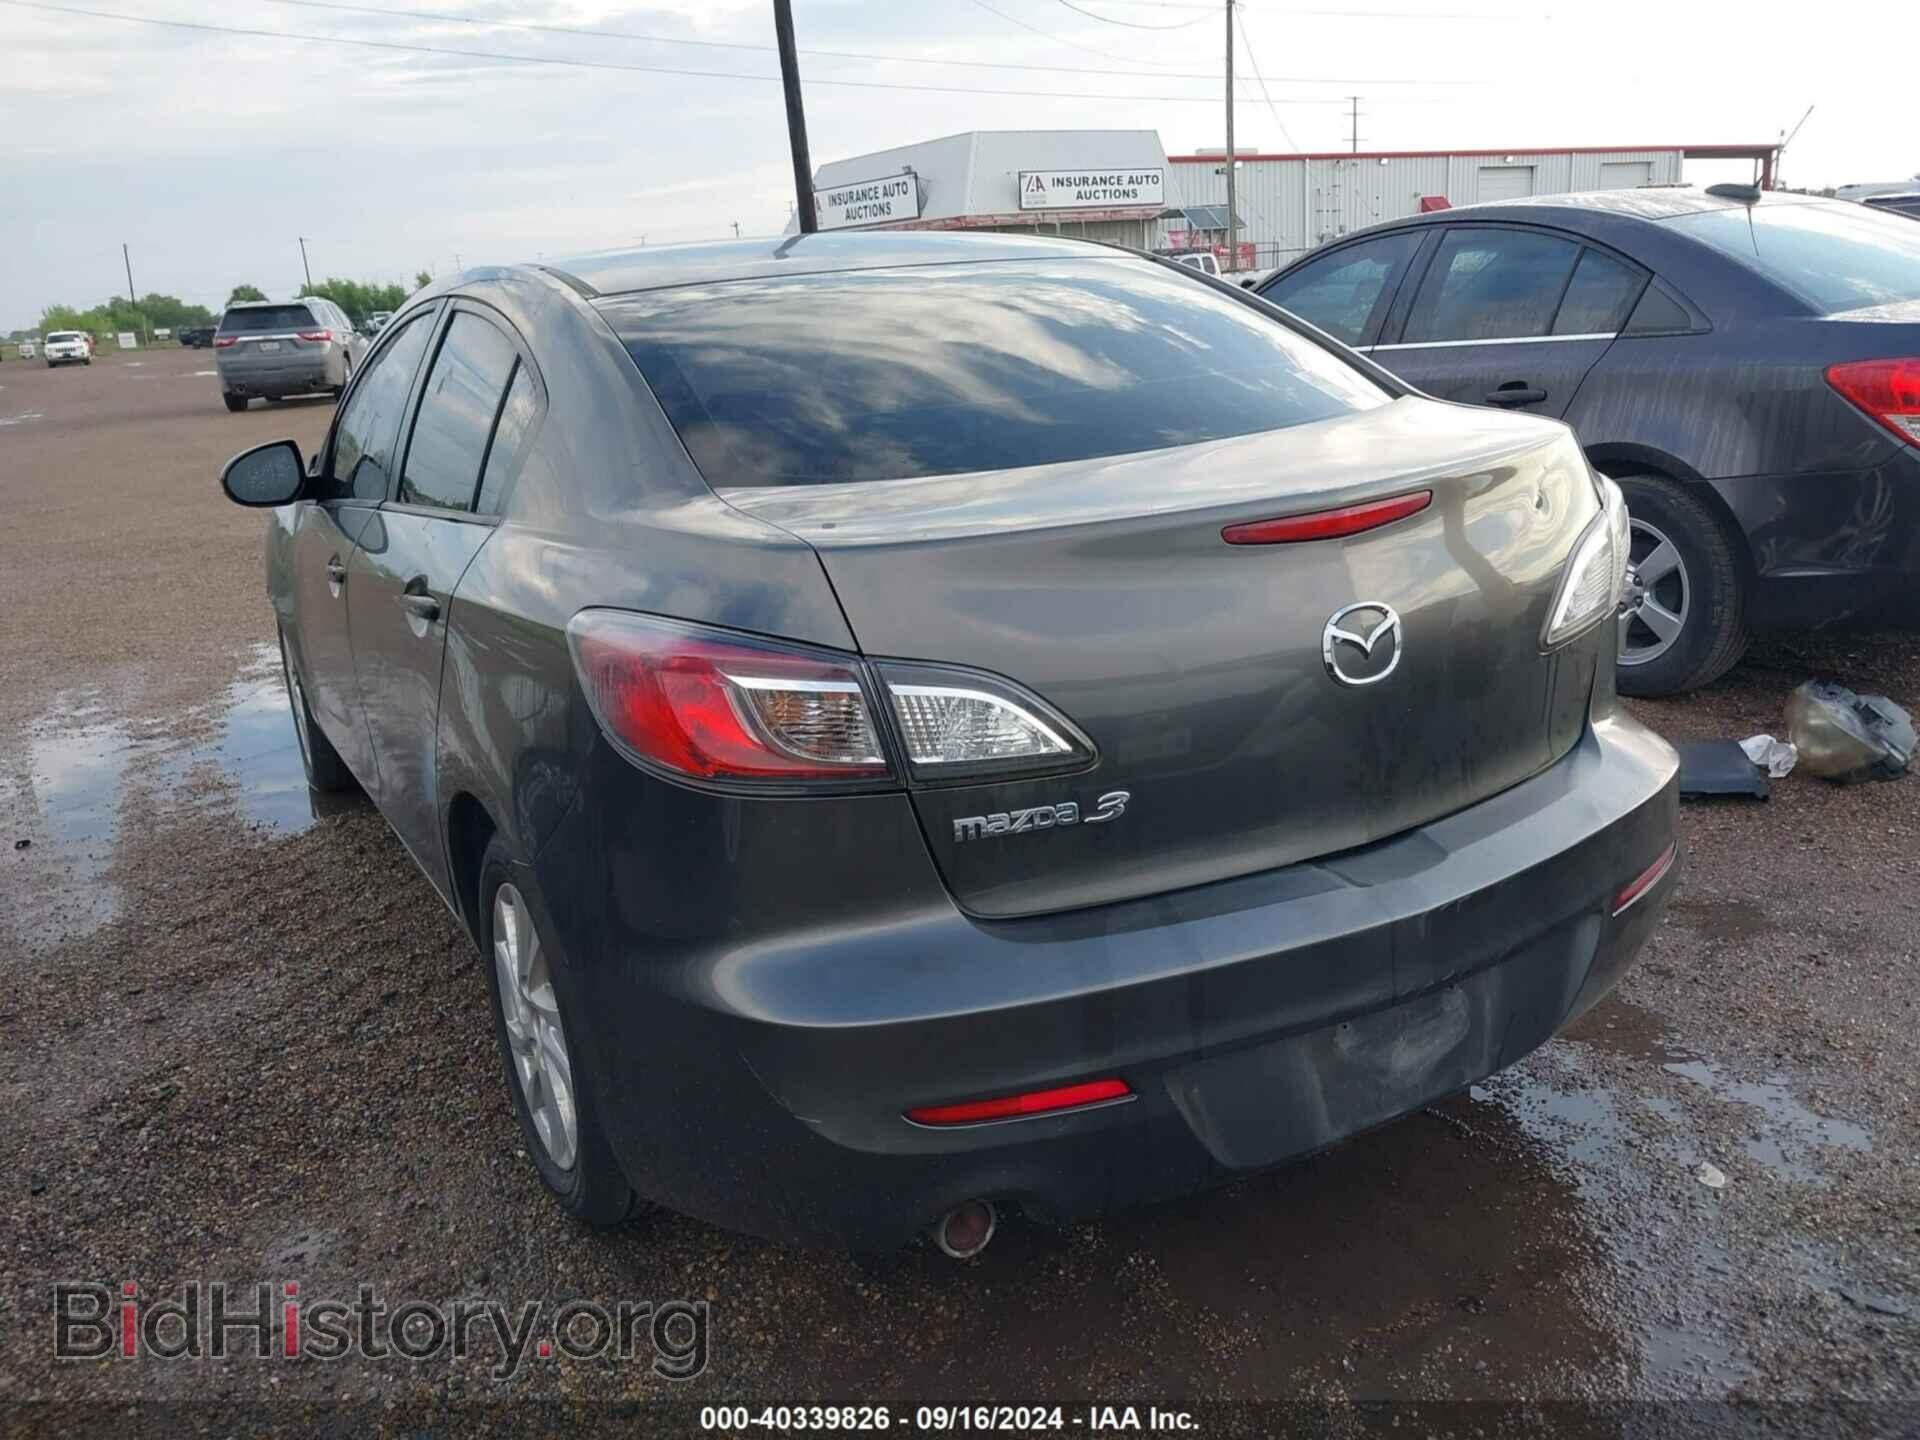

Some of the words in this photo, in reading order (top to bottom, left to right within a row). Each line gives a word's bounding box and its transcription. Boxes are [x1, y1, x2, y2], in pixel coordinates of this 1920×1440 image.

[1052, 175, 1123, 188] INSURANCE
[1128, 174, 1160, 186] AUTO
[827, 186, 880, 208] INSURANCE
[882, 181, 908, 198] AUTO
[1076, 188, 1138, 200] AUCTIONS
[845, 201, 892, 221] AUCTIONS
[1083, 790, 1131, 823] 3
